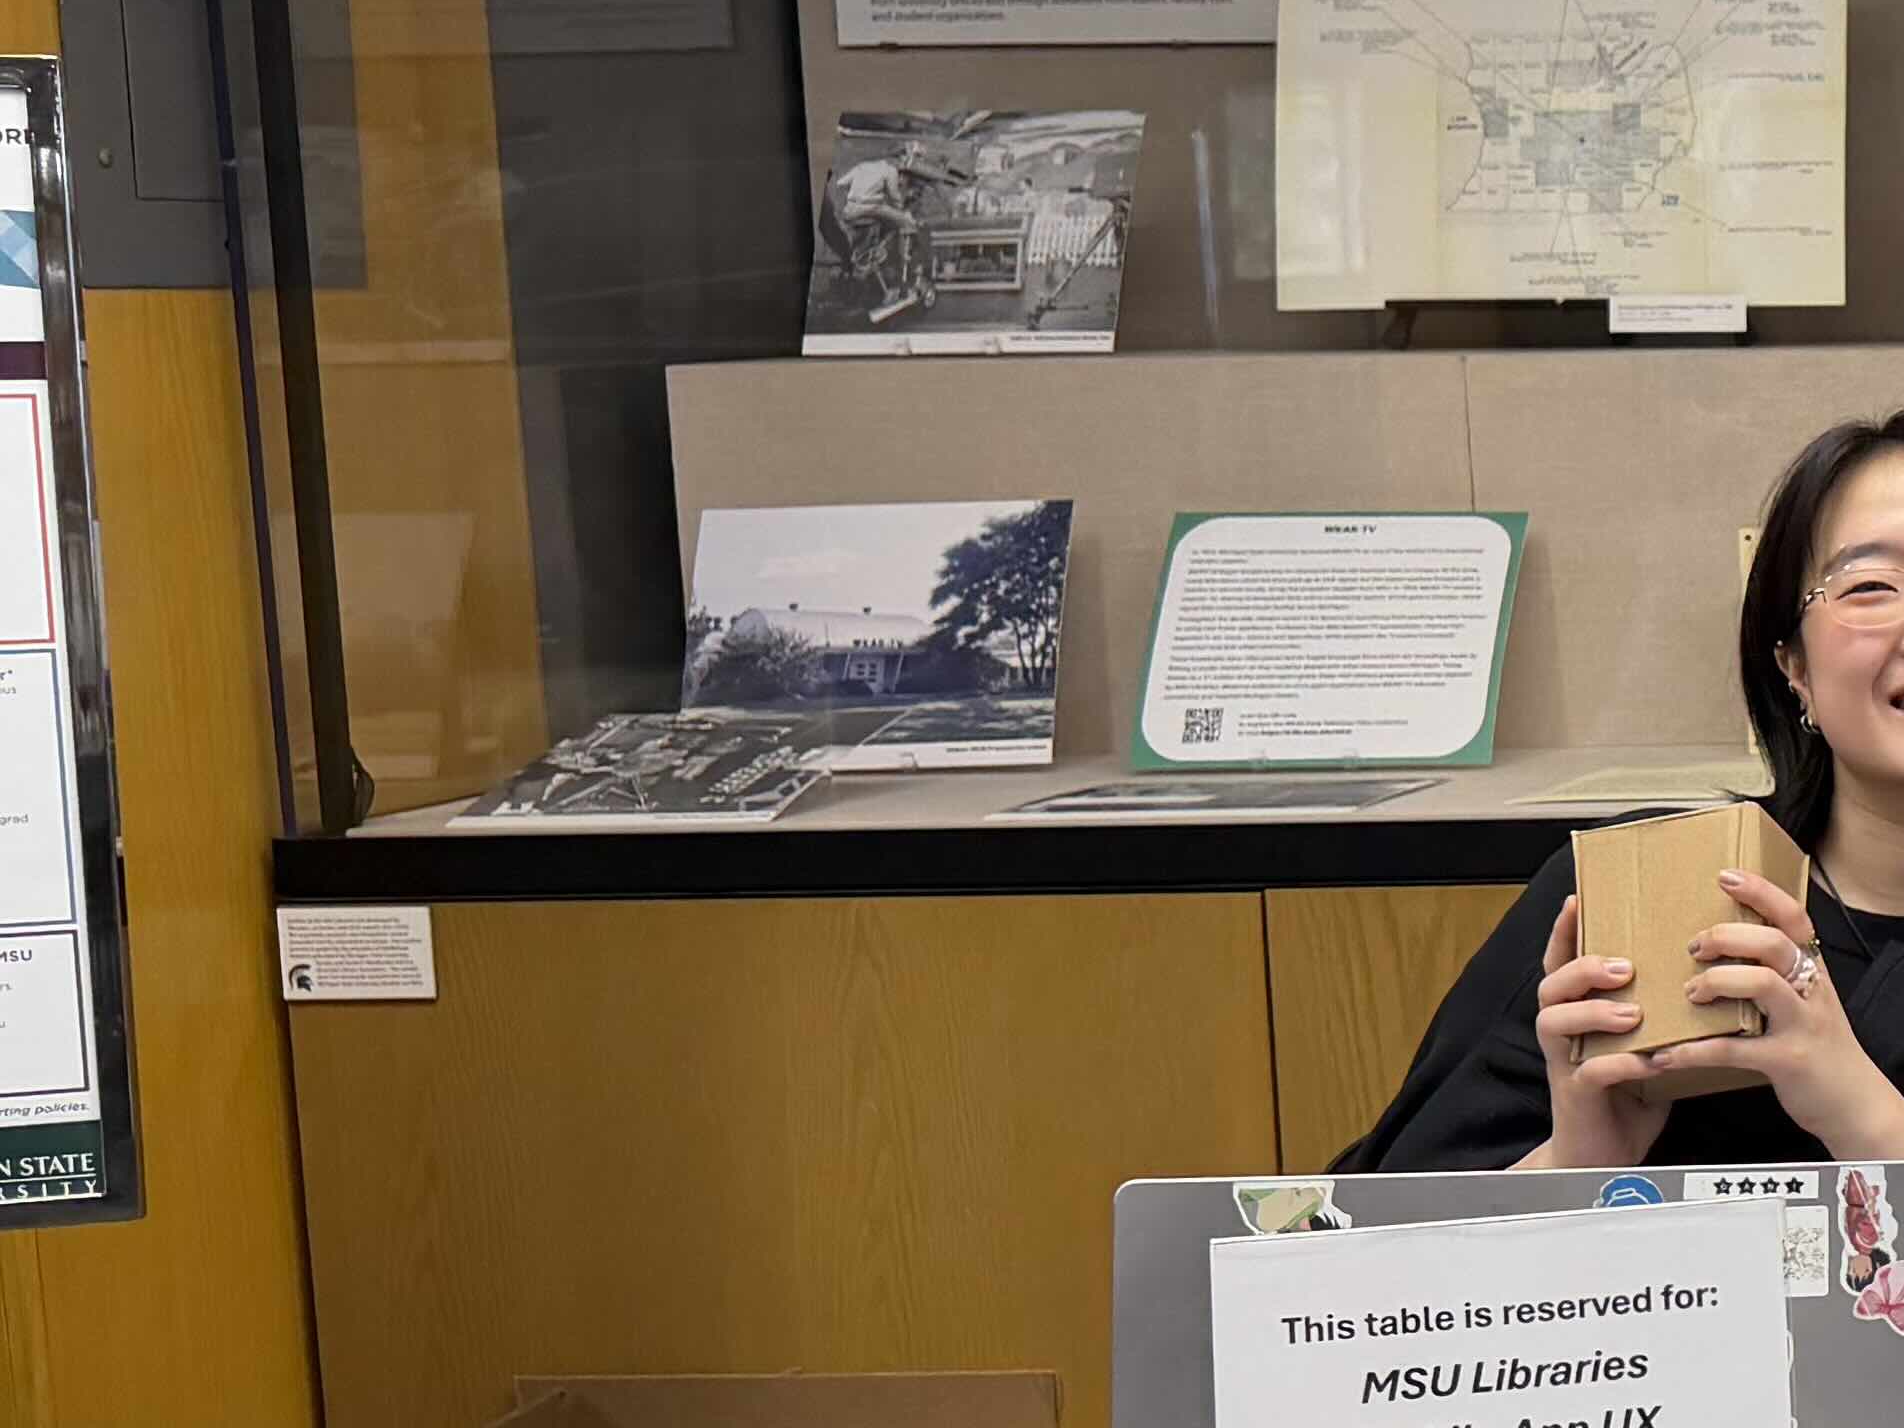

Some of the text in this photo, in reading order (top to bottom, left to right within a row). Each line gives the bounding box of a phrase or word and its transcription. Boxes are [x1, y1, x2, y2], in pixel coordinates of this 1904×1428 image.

[20, 1153, 96, 1177] STATE
[1281, 1284, 1717, 1344] This table is reserved for:
[1362, 1351, 1648, 1404] MSU Libraries
